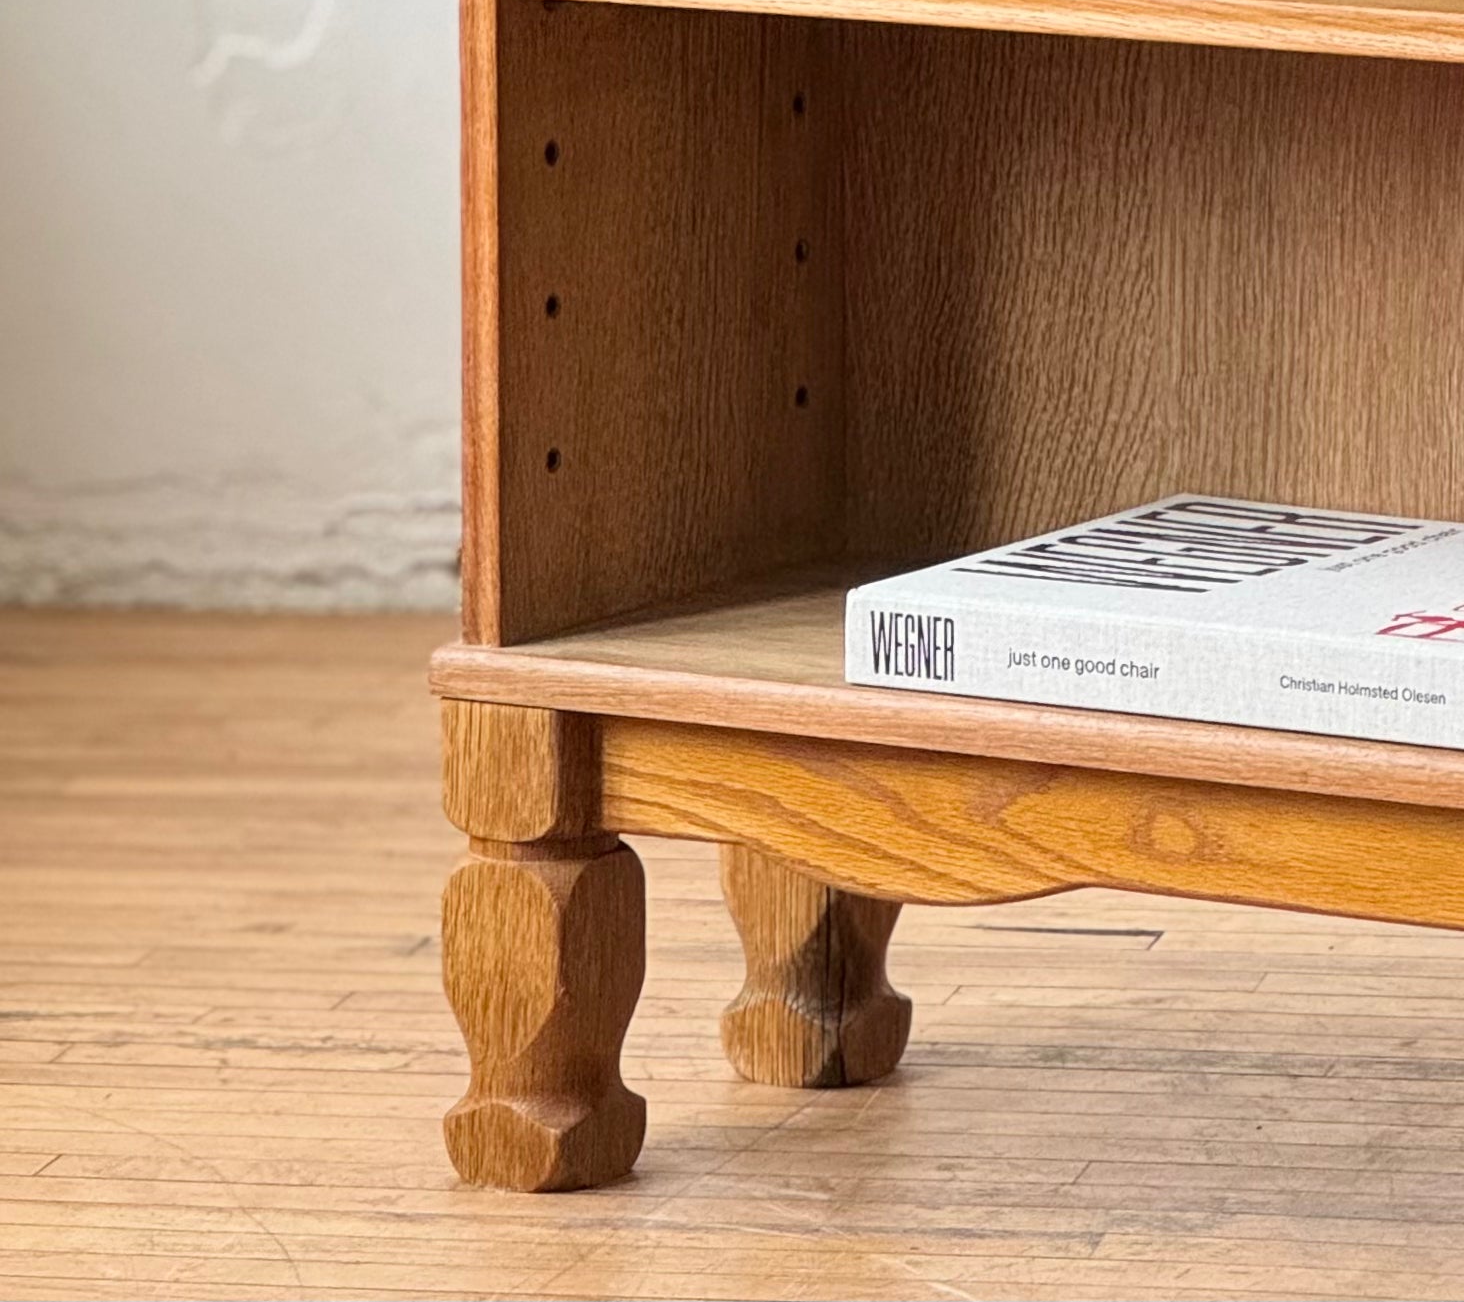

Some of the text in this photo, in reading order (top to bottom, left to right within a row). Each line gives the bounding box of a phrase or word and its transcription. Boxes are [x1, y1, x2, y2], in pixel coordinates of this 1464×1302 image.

[951, 500, 1425, 592] WEGNER
[869, 609, 955, 682] WEGNER
[1006, 647, 1161, 680] just one good chair
[1279, 674, 1447, 706] Christian Holmsted Olesen
